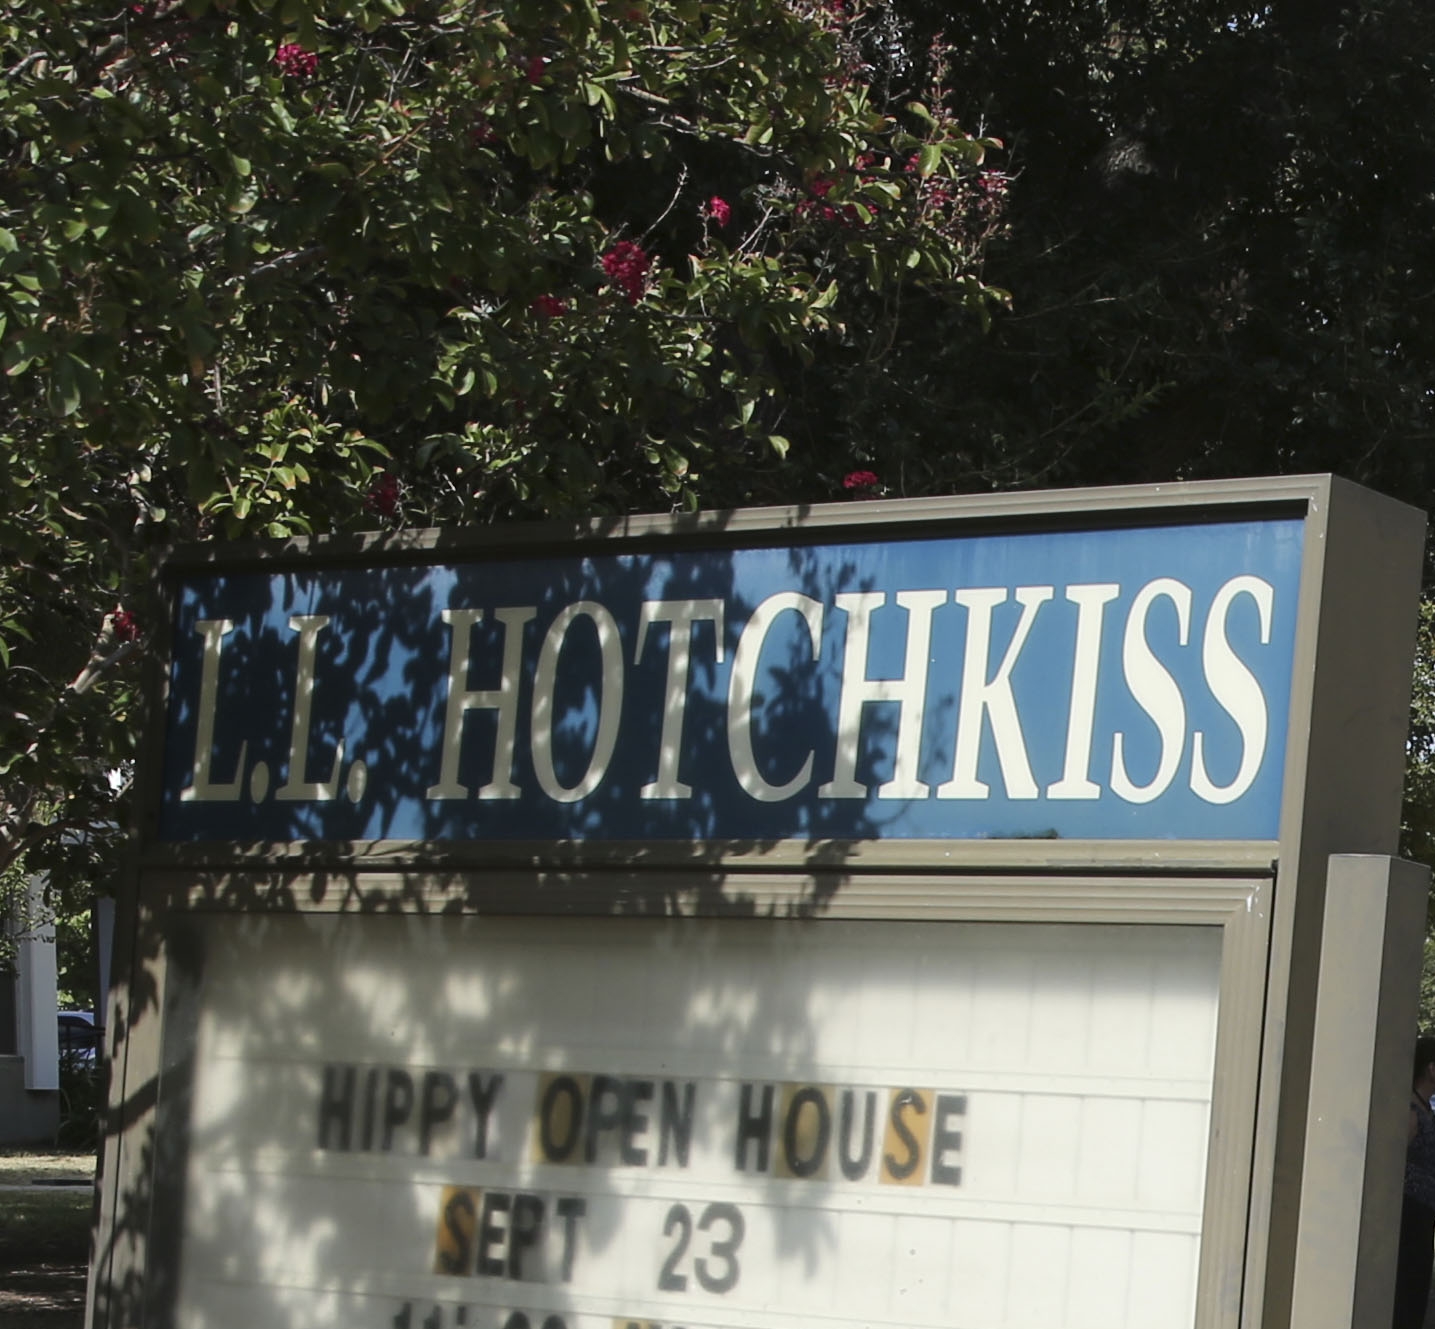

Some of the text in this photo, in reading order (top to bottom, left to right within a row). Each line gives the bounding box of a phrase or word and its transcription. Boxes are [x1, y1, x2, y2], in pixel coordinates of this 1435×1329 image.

[180, 575, 1274, 804] L.L. HOTCHKISS
[317, 1063, 968, 1187] HIPPY OPEN HOUSE
[442, 1189, 746, 1295] SEPT 23
